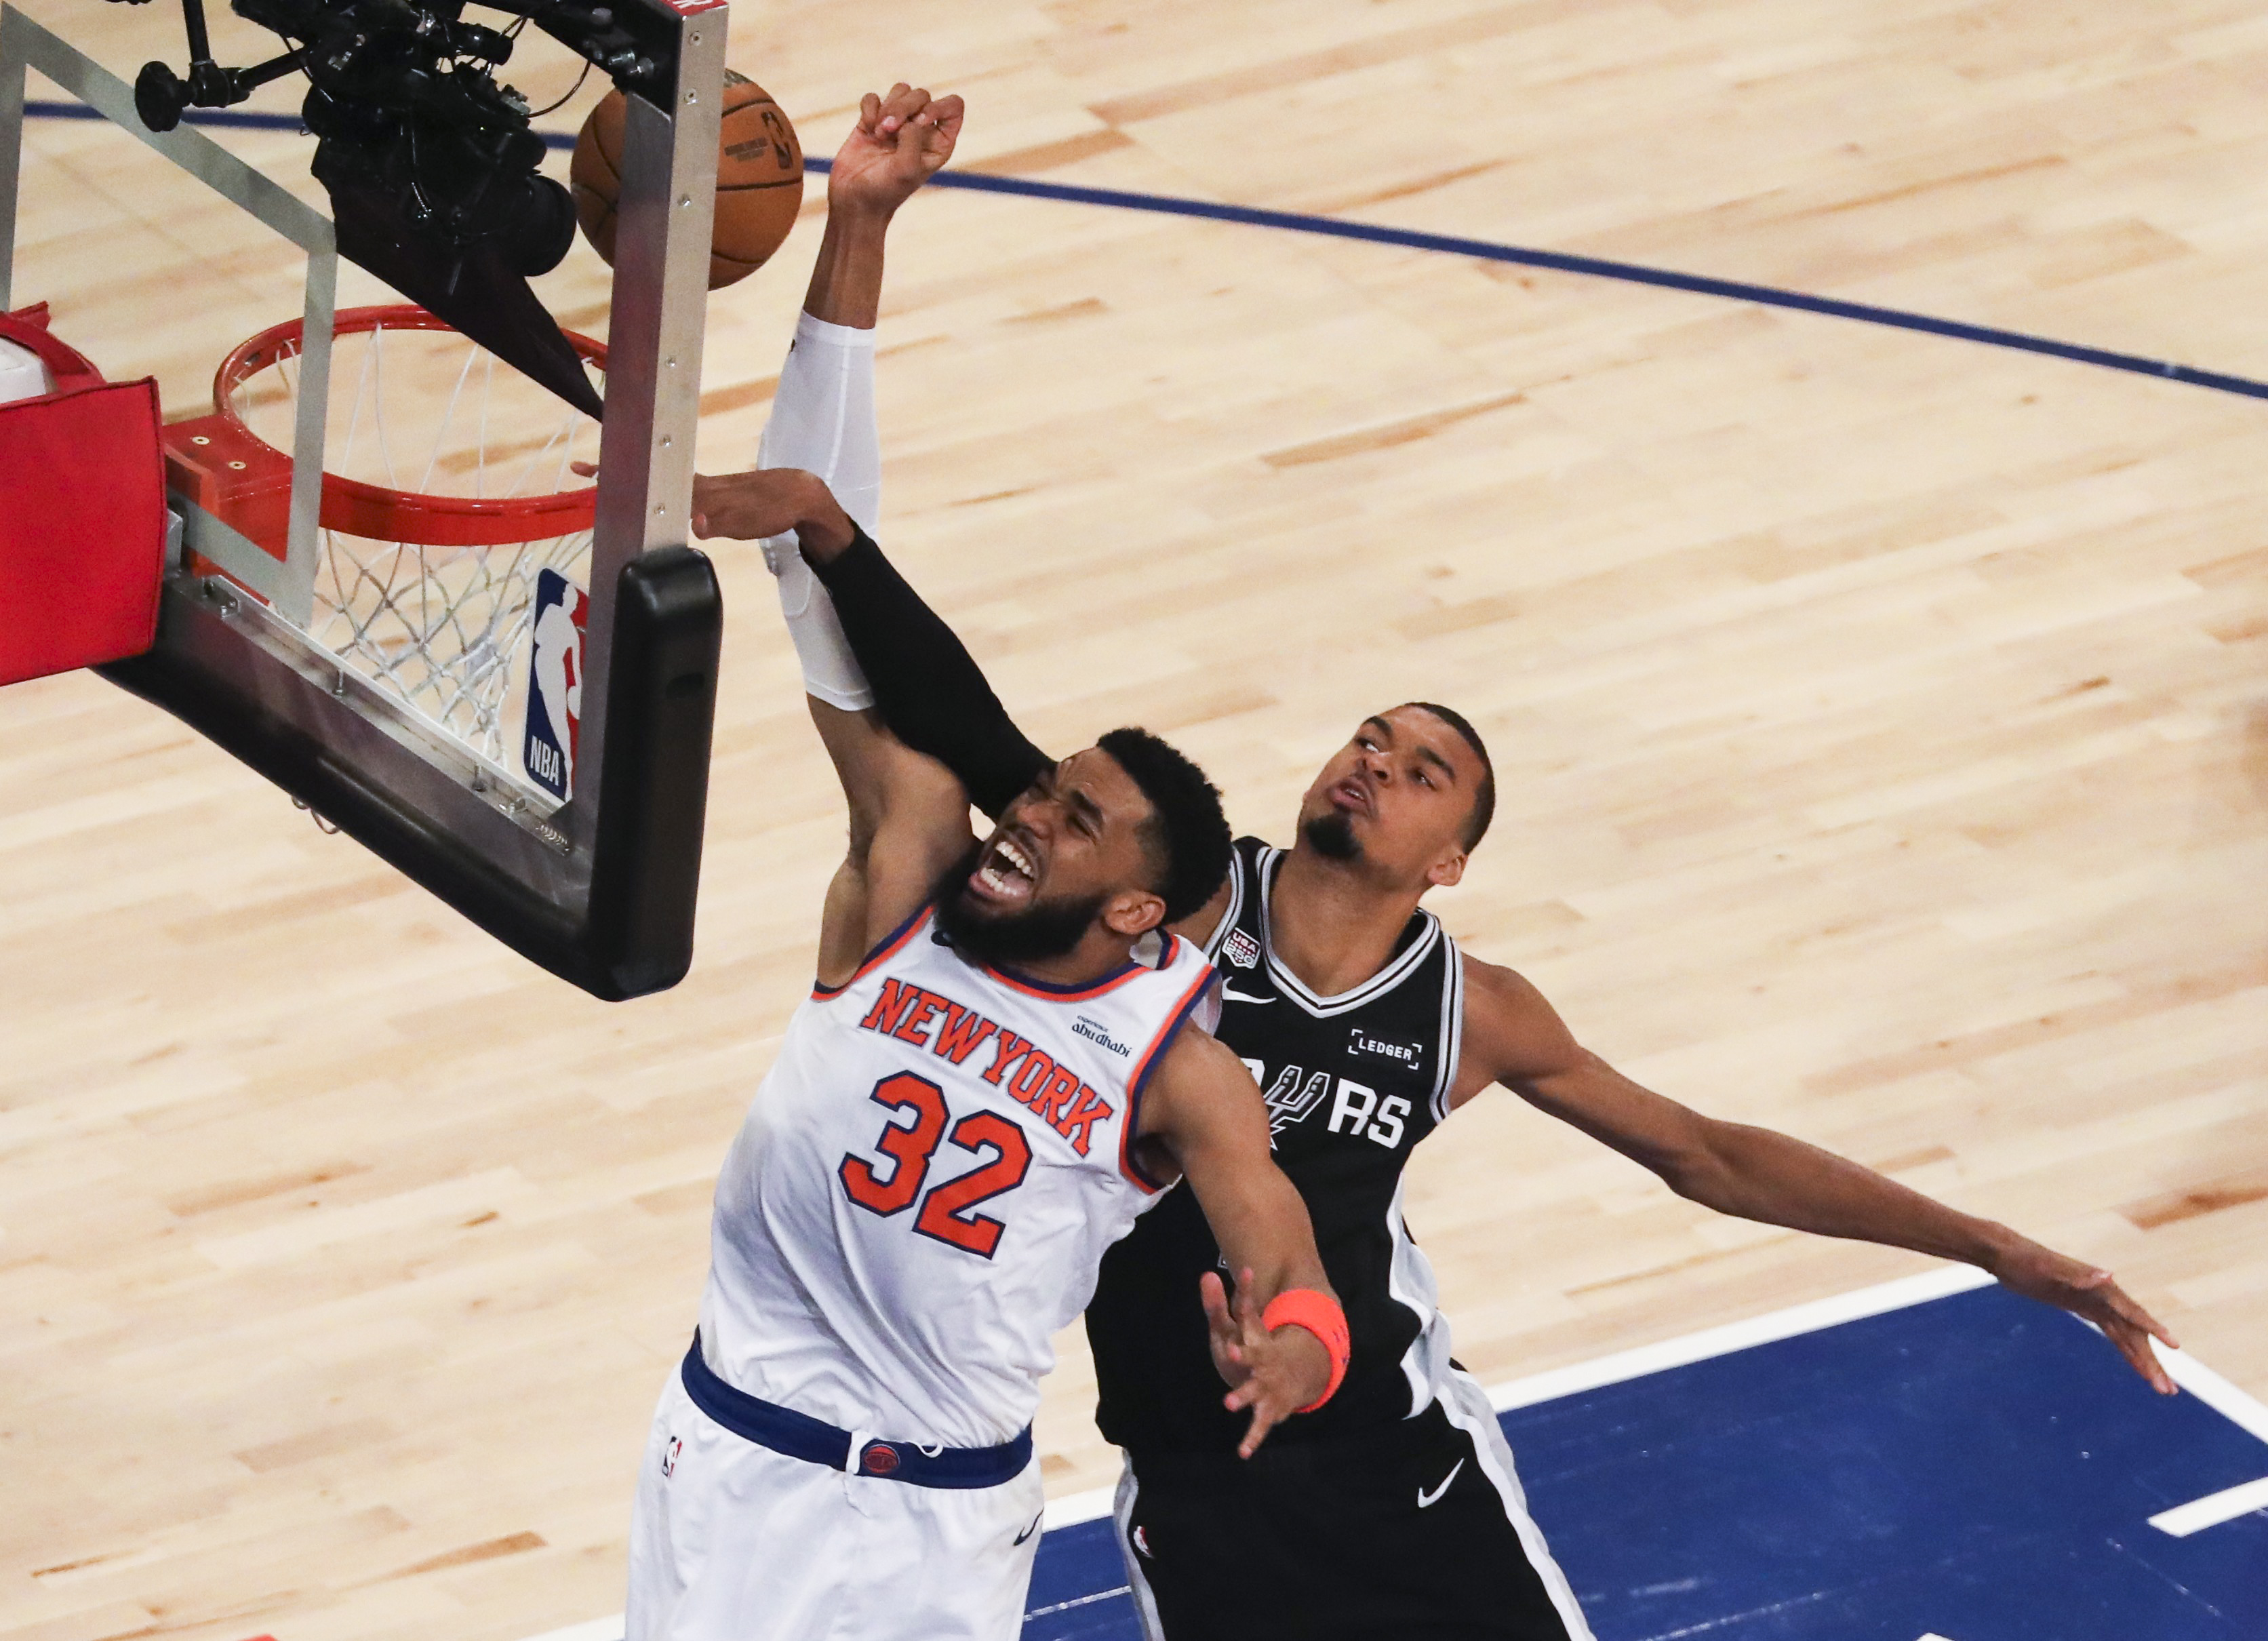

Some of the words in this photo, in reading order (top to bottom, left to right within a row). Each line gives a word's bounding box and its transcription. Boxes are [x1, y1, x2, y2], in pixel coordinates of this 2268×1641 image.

[530, 735, 560, 787] NBA
[1226, 943, 1254, 966] 250
[1233, 932, 1256, 953] USA
[1071, 1023, 1096, 1040] abu
[1095, 1033, 1132, 1058] dhabi
[1357, 1037, 1412, 1061] LEDGER
[860, 976, 996, 1066] NEW
[982, 1029, 1115, 1158] YORK
[1239, 1056, 1412, 1151] URS
[837, 1069, 1033, 1260] 32
